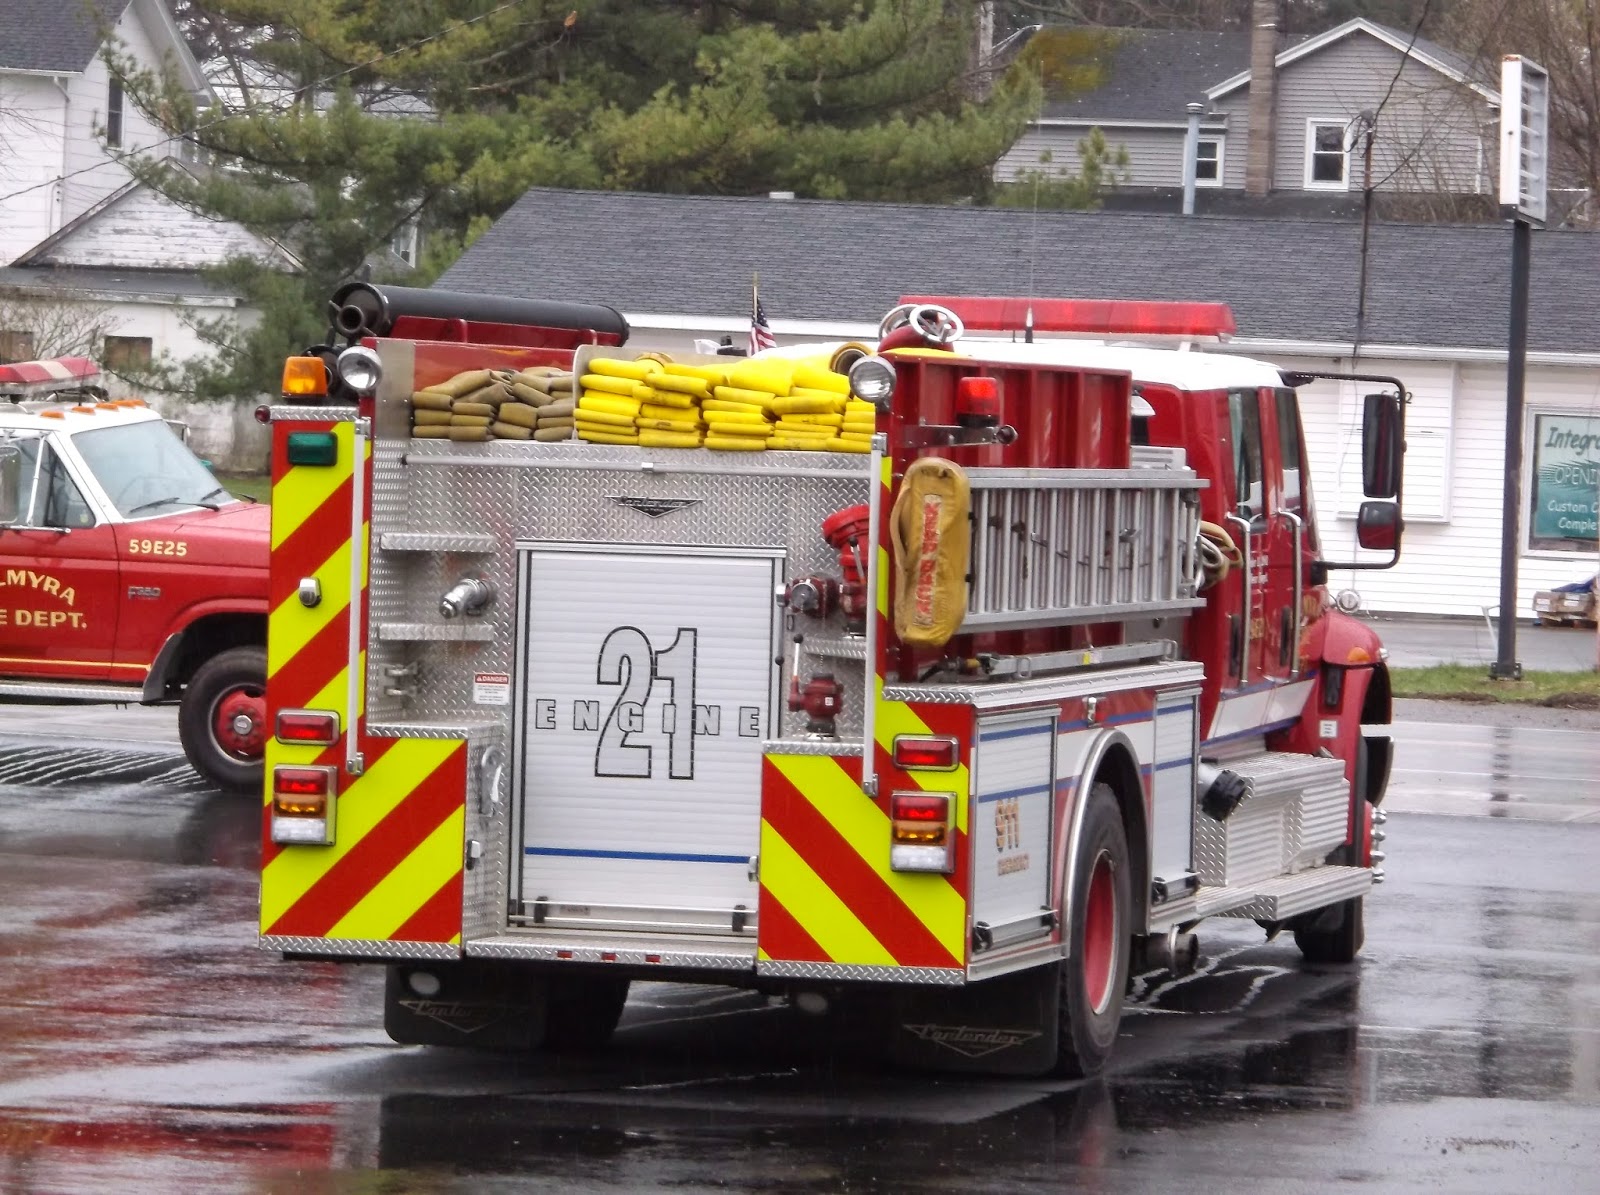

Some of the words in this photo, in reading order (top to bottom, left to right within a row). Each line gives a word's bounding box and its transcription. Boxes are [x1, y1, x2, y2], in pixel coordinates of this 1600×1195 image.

[1547, 500, 1588, 513] Custom
[129, 539, 188, 556] 59E25
[15, 609, 87, 628] DEPT.
[482, 675, 508, 683] DANGER
[594, 625, 697, 780] 21
[535, 699, 760, 737] ENGINE
